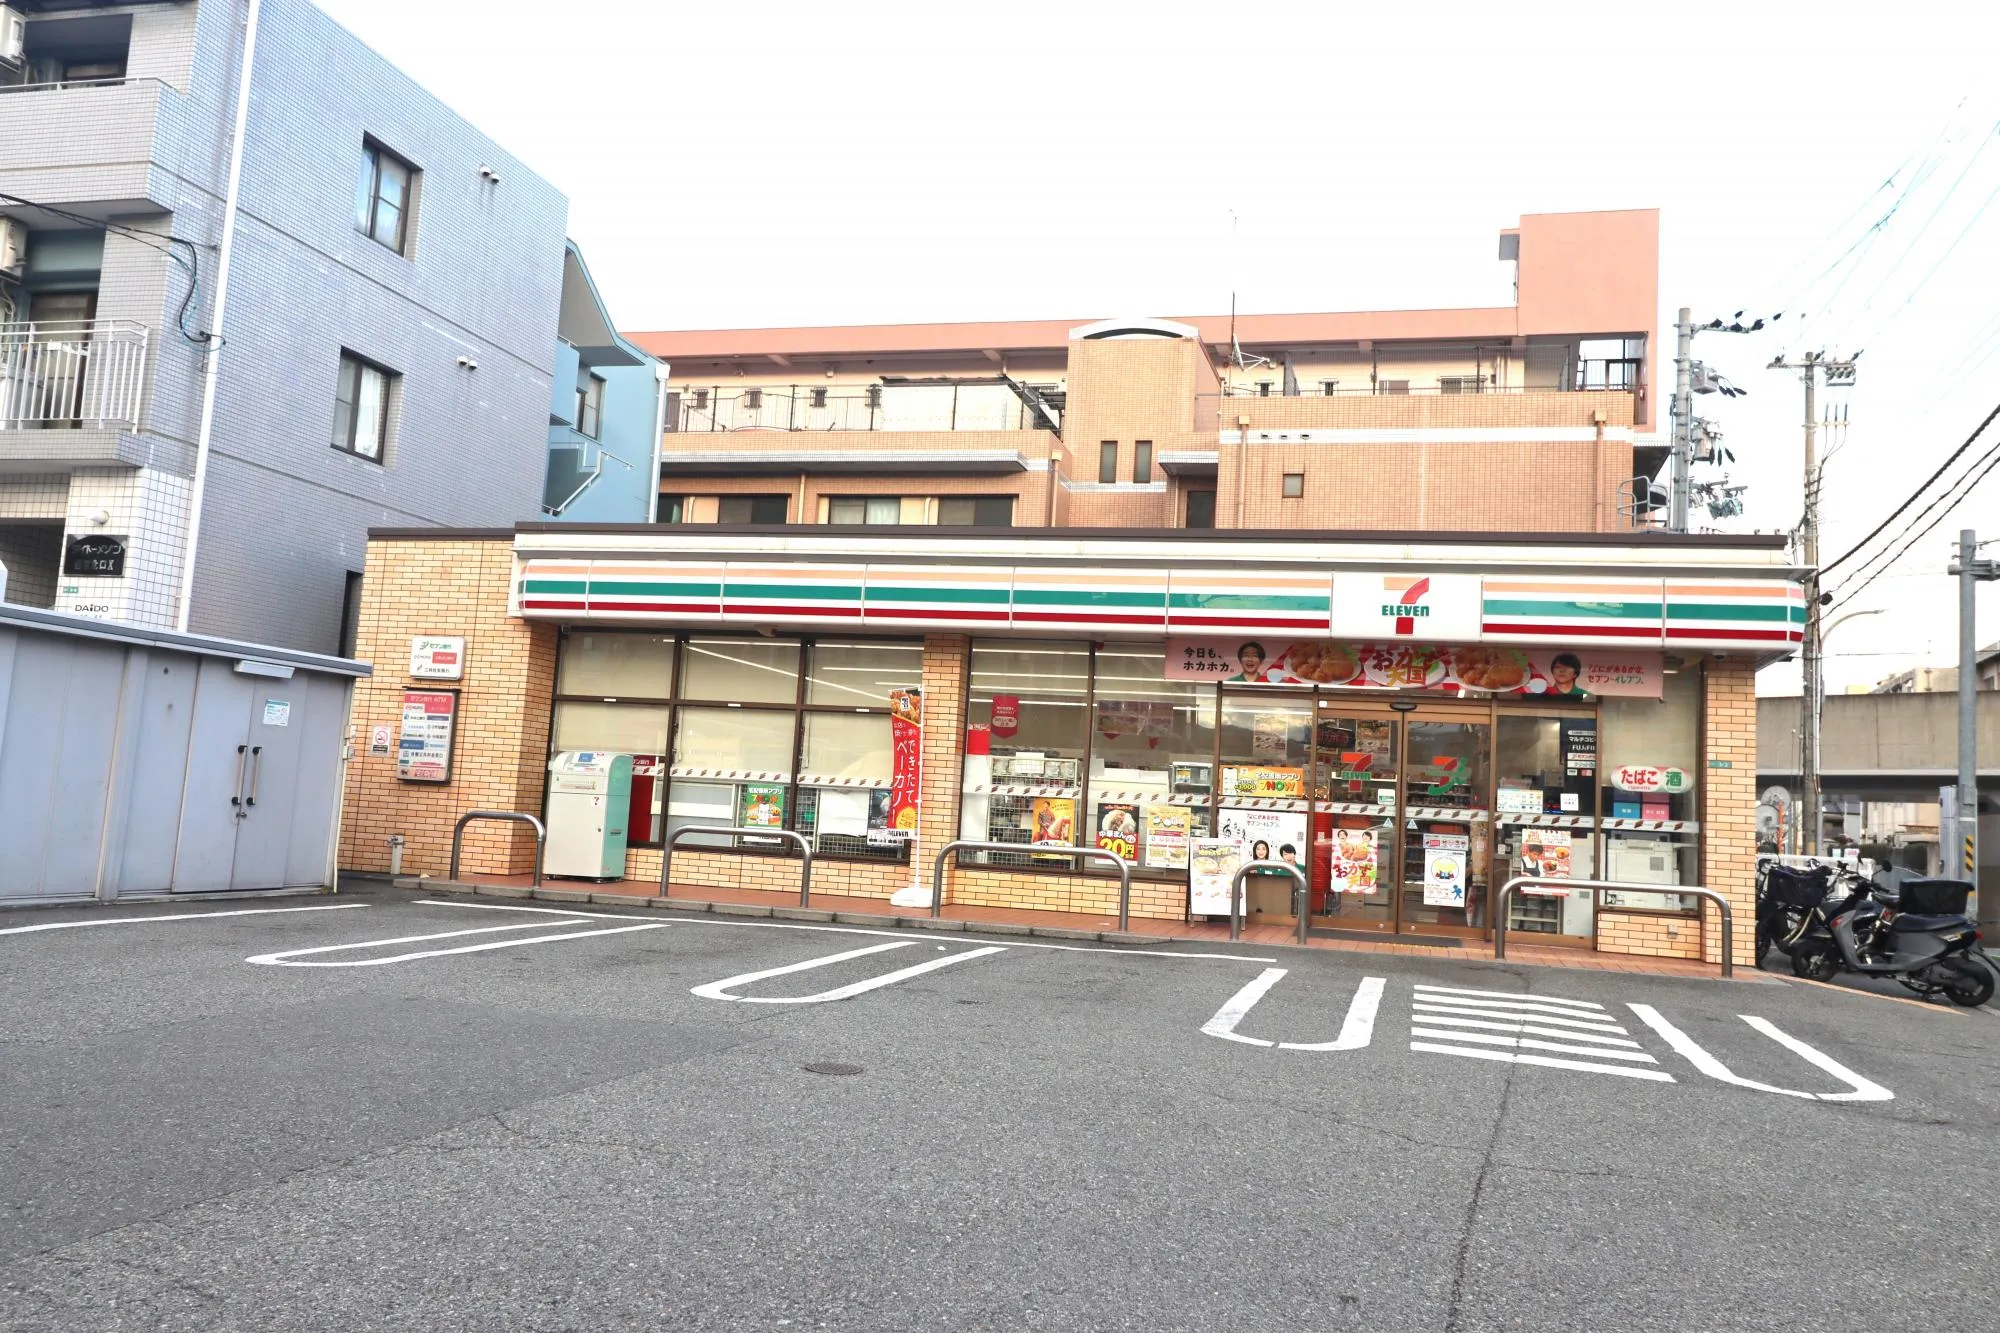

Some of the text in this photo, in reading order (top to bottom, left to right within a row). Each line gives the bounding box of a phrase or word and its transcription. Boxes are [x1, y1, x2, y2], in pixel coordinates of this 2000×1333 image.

[1183, 646, 1222, 659] 今日も、
[1183, 660, 1235, 673] ホカホカ。
[905, 740, 917, 804] できたて
[1621, 769, 1658, 785] たばこ
[1665, 771, 1682, 787] 酒
[892, 740, 909, 823] ベーカリー
